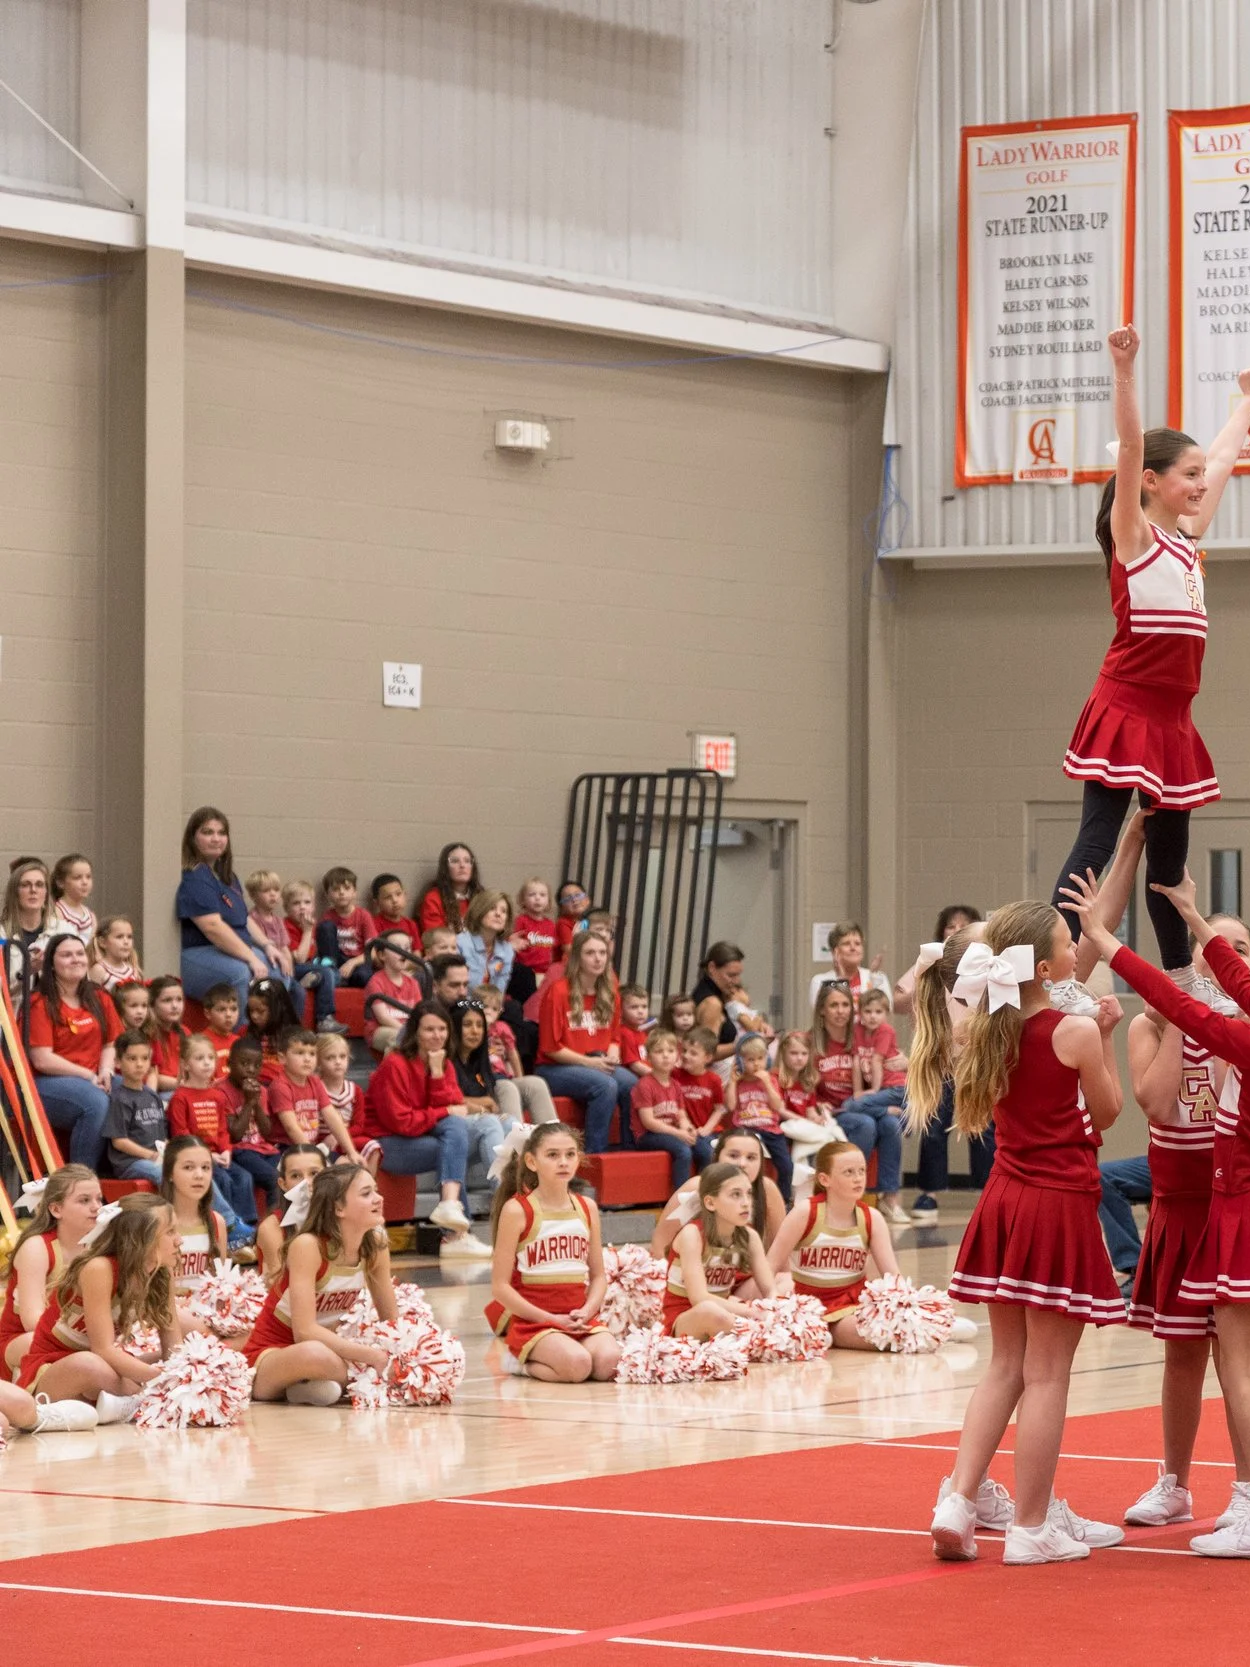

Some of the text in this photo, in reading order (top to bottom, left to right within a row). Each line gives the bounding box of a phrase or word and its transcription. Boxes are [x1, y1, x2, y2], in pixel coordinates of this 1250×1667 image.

[1193, 132, 1245, 153] LADY
[976, 140, 1120, 167] LADY WARRIOR
[1026, 169, 1069, 185] GOLF
[1026, 194, 1069, 215] 2021
[985, 212, 1109, 237] STATE RUNNER-UP
[1193, 210, 1240, 235] STATE
[1000, 251, 1094, 270] BROOKLYN LANE
[1005, 274, 1088, 291] HALEY CARNES
[1002, 296, 1090, 314] KELSEY WILSON
[997, 318, 1094, 336] MADDIE HOOKER
[989, 344, 1034, 359] SYDNEY
[705, 741, 729, 770] EXIT
[800, 1247, 867, 1271] WARRIORS
